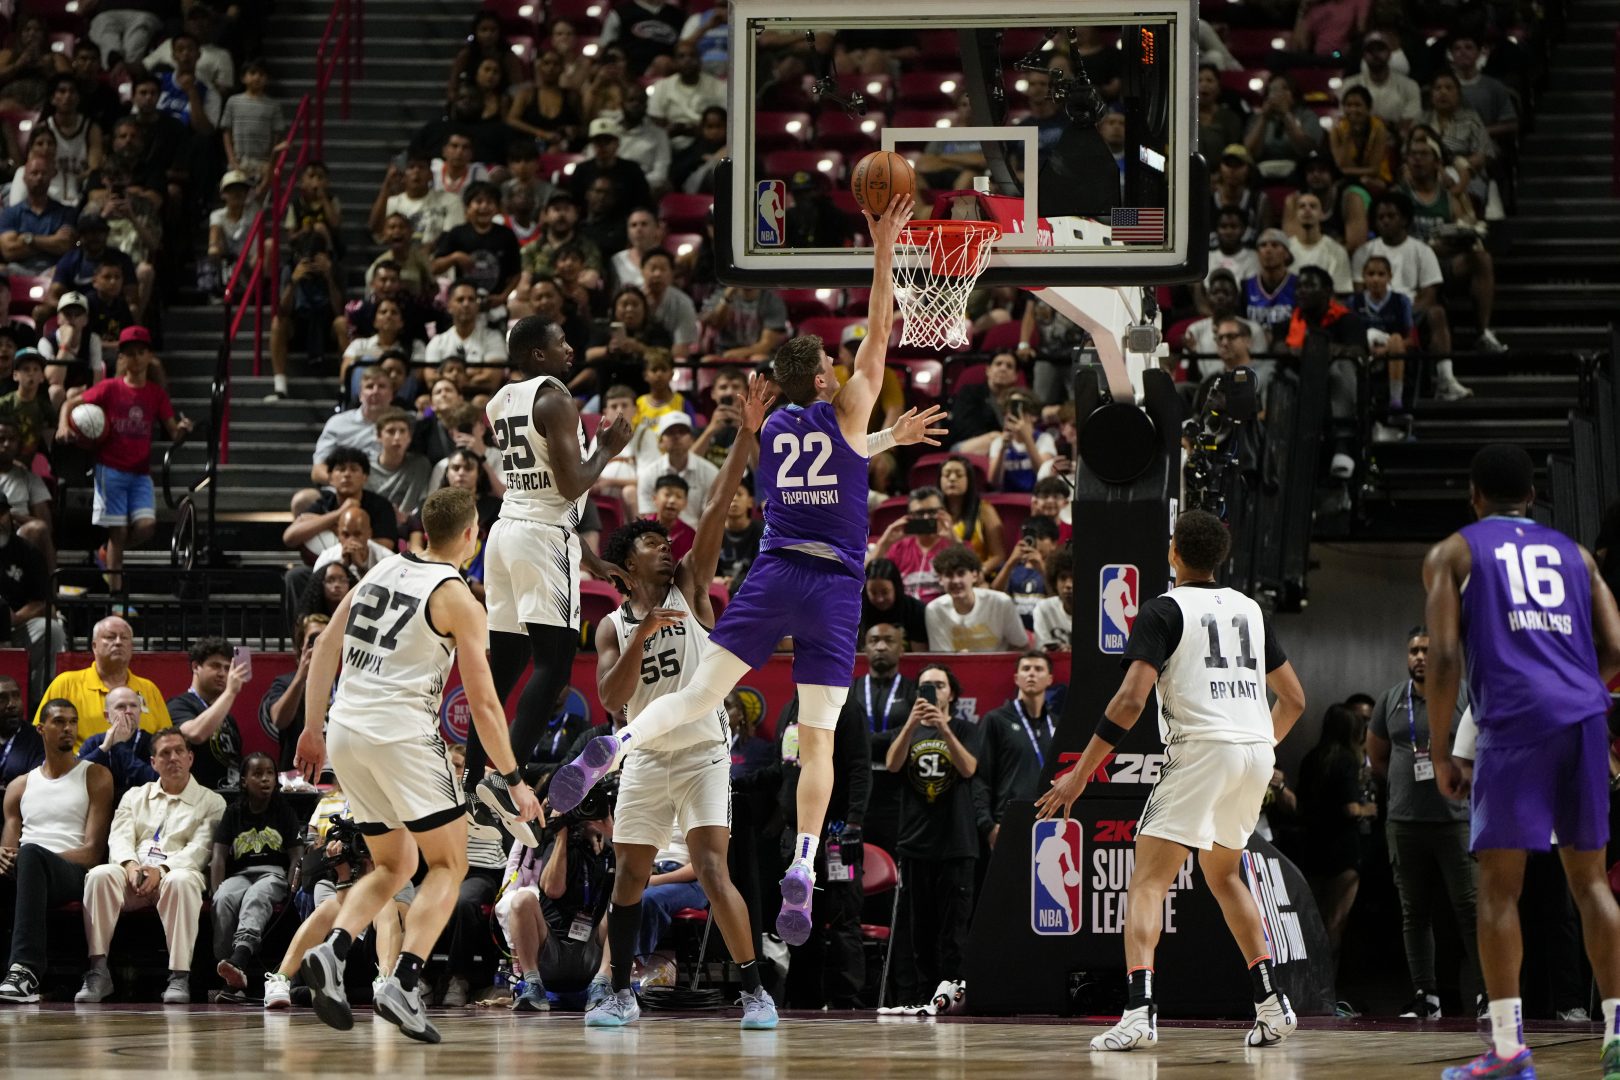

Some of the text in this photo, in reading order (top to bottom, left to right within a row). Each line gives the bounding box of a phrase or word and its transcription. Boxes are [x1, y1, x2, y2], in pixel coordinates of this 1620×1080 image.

[760, 231, 775, 242] NBA
[493, 414, 537, 472] 25
[772, 431, 839, 489] 22
[506, 470, 552, 491] ES-GRCIA
[1494, 541, 1567, 608] 16
[344, 582, 422, 651] 27
[1104, 634, 1124, 649] NBA
[1200, 613, 1258, 670] 11
[640, 648, 681, 685] 55
[918, 753, 946, 778] SL
[1092, 819, 1139, 842] 2K
[1092, 848, 1194, 890] SUR
[1039, 909, 1063, 928] NBA
[1092, 891, 1177, 933] LEAE
